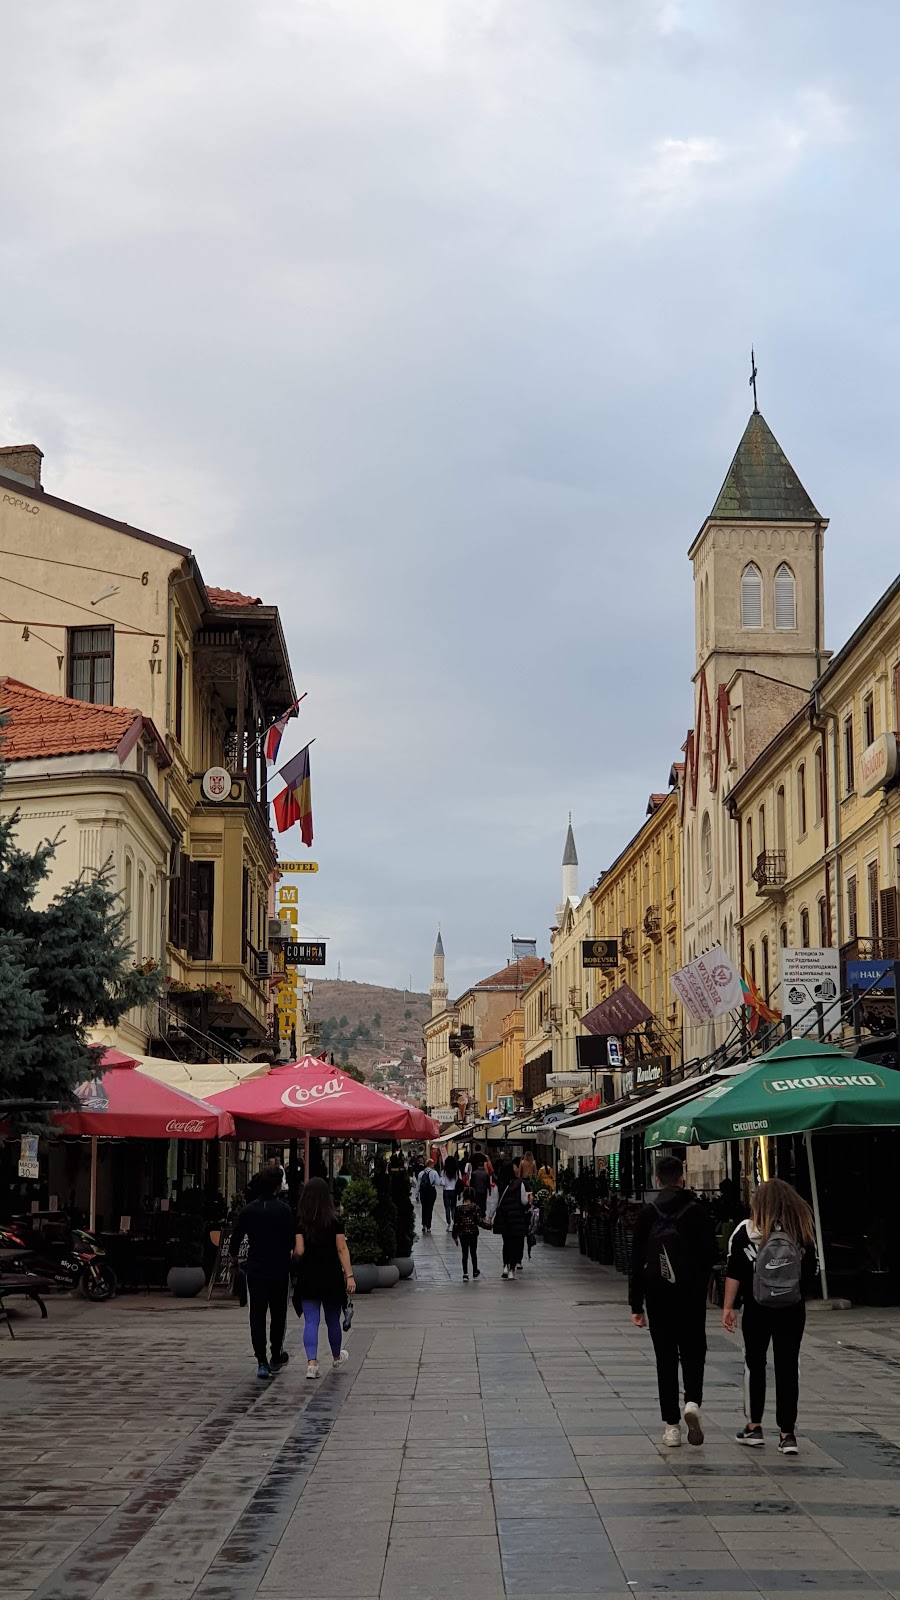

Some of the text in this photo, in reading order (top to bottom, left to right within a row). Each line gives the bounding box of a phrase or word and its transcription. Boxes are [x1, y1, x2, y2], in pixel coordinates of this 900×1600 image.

[3, 494, 40, 515] POPULO
[141, 571, 149, 586] 6
[21, 626, 30, 642] 4
[152, 639, 160, 654] 5
[56, 655, 65, 670] V
[148, 659, 162, 674] VI
[281, 863, 315, 871] HOTEL
[697, 961, 722, 1006] WINNER
[636, 1064, 661, 1083] Roulette
[771, 1075, 877, 1091] СКОПСКО
[733, 1120, 769, 1132] СКОПСКО
[20, 1168, 31, 1177] 30
